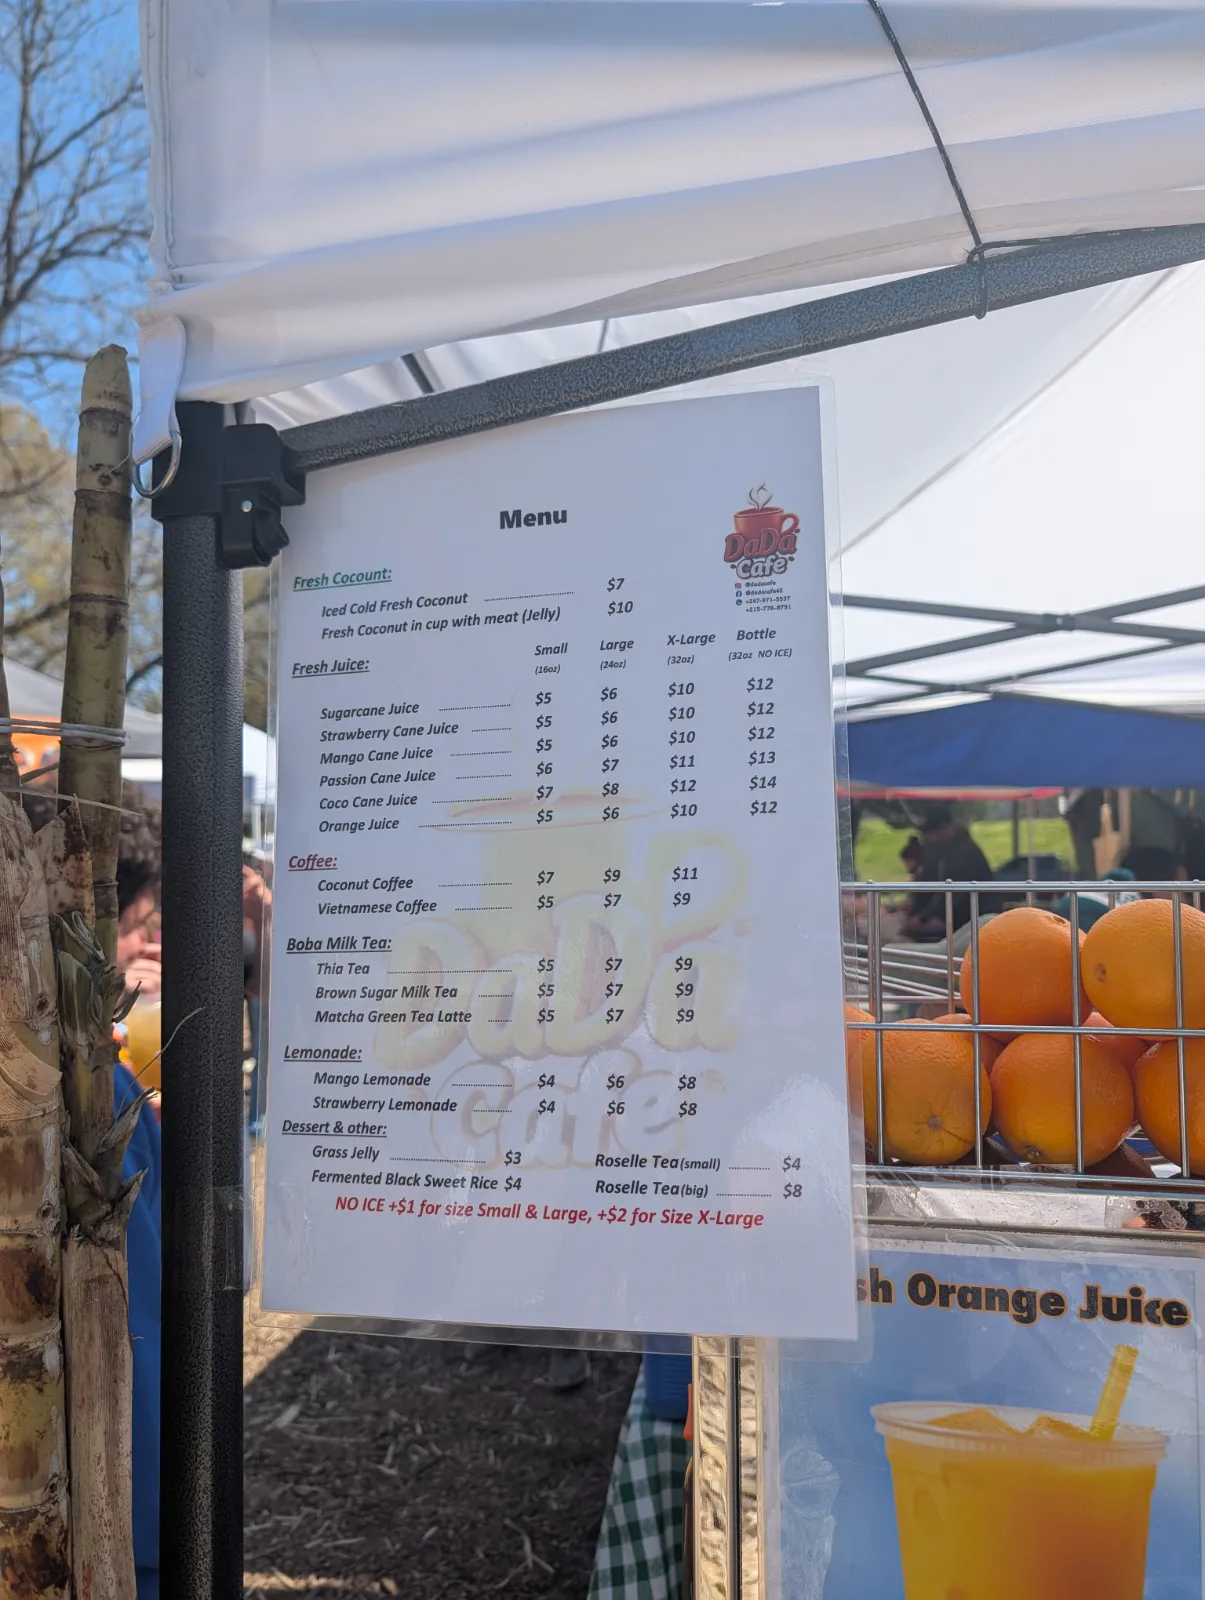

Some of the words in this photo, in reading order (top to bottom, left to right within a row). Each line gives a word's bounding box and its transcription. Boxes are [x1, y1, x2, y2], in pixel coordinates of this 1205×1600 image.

[500, 509, 568, 529] Menu
[724, 528, 797, 562] DaDa
[736, 553, 788, 579] Cafe
[293, 573, 328, 590] Fresh
[332, 568, 392, 585] Cocount:
[322, 605, 346, 618] Iced
[350, 601, 376, 615] Cold
[380, 597, 412, 612] Fresh
[416, 593, 468, 608] Coconut
[607, 578, 624, 592] $7
[322, 626, 354, 639] Fresh
[357, 620, 407, 636] Coconut
[411, 619, 422, 632] in
[426, 619, 448, 631] cup
[452, 612, 480, 627] with
[484, 613, 518, 625] meat
[522, 606, 561, 624] (Jelly)
[607, 600, 633, 615] $10
[535, 642, 568, 656] Small
[600, 639, 634, 652] Large
[667, 633, 716, 646] X-Large
[736, 628, 776, 641] Bottle
[292, 662, 328, 676] Fresh
[331, 657, 370, 673] Juice:
[535, 665, 561, 675] (16oz)
[600, 659, 626, 671] (24oz)
[667, 655, 694, 665] (32oz)
[729, 650, 752, 661] (32oz
[758, 650, 772, 658] NO
[774, 648, 792, 658] ICE)
[320, 705, 385, 722] Sugarcane
[388, 702, 419, 716] Juice
[535, 692, 552, 706] $5
[601, 687, 617, 701] $6
[668, 682, 694, 697] $10
[747, 677, 774, 693] $12
[320, 728, 390, 742] Strawberry
[393, 725, 425, 737] Cane
[427, 723, 458, 736] Juice
[536, 715, 552, 729] $5
[601, 711, 618, 726] $6
[669, 707, 695, 721] $10
[747, 702, 774, 717] $12
[320, 750, 364, 765] Mango
[368, 750, 398, 761] Cane
[402, 748, 433, 760] Juice
[536, 739, 552, 753] $5
[601, 735, 618, 749] $6
[669, 731, 695, 745] $10
[748, 727, 775, 741] $12
[320, 773, 367, 787] Passion
[370, 772, 401, 784] Cane
[404, 770, 436, 783] Juice
[536, 762, 552, 777] $6
[602, 759, 619, 773] $7
[670, 755, 695, 770] $11
[749, 751, 775, 766] $13
[319, 798, 349, 809] Coco
[352, 796, 383, 808] Cane
[386, 794, 417, 807] Juice
[536, 786, 553, 800] $7
[602, 783, 619, 797] $8
[670, 780, 696, 794] $12
[749, 776, 777, 790] $14
[319, 821, 365, 834] Orange
[368, 819, 399, 830] Juice
[536, 809, 553, 824] $5
[602, 807, 619, 821] $6
[671, 804, 697, 819] $10
[750, 800, 777, 815] $12
[288, 854, 337, 870] Coffee:
[318, 879, 368, 892] Coconut
[372, 877, 413, 891] Coffee
[537, 871, 554, 886] $7
[603, 869, 620, 884] $9
[672, 867, 698, 882] $11
[318, 902, 392, 915] Vietnamese
[395, 901, 437, 915] Coffee
[537, 895, 554, 910] $5
[604, 894, 621, 909] $7
[673, 892, 690, 906] $9
[287, 938, 322, 950] Boba
[326, 936, 357, 950] Milk
[361, 937, 392, 949] Tea:
[317, 963, 343, 975] Thia
[347, 963, 370, 974] Tea
[538, 958, 554, 973] $5
[605, 958, 623, 972] $7
[675, 956, 692, 971] $9
[315, 986, 357, 999] Brown
[360, 987, 398, 1001] Sugar
[401, 985, 430, 999] Milk
[434, 986, 457, 998] Tea
[538, 983, 554, 998] $5
[605, 982, 623, 997] $7
[675, 982, 693, 997] $9
[315, 1010, 364, 1023] Matcha
[367, 1011, 406, 1023] Green
[411, 1011, 433, 1022] Tea
[437, 1011, 472, 1022] Latte
[538, 1008, 555, 1023] $5
[606, 1008, 624, 1023] $7
[676, 1008, 694, 1024] $9
[284, 1045, 362, 1060] Lemonade:
[314, 1072, 360, 1087] Mango
[363, 1073, 431, 1086] Lemonade
[538, 1074, 555, 1089] $4
[607, 1075, 625, 1090] $6
[678, 1075, 696, 1091] $8
[313, 1097, 384, 1112] Strawberry
[388, 1099, 457, 1112] Lemonade
[538, 1099, 556, 1114] $4
[607, 1101, 625, 1116] $6
[678, 1101, 697, 1117] $8
[282, 1120, 330, 1133] Dessert
[333, 1122, 343, 1133] &
[347, 1122, 387, 1135] other:
[312, 1146, 348, 1159] Grass
[351, 1147, 379, 1162] Jelly
[504, 1150, 521, 1165] $3
[595, 1154, 647, 1168] Roselle
[782, 1156, 801, 1171] $4
[312, 1170, 381, 1185] Fermented
[385, 1173, 420, 1187] Black
[424, 1175, 466, 1188] Sweet
[470, 1176, 498, 1189] Rice
[504, 1176, 522, 1191] $4
[595, 1180, 648, 1194] Roselle
[783, 1183, 802, 1199] $8
[335, 1197, 359, 1210] NO
[362, 1198, 385, 1211] ICE
[389, 1197, 414, 1214] +$1
[418, 1200, 442, 1217] for
[445, 1203, 473, 1216] size
[477, 1202, 521, 1218] Small
[525, 1204, 537, 1219] &
[543, 1205, 592, 1224] Large,
[597, 1206, 627, 1225] +$2
[630, 1207, 656, 1226] for
[661, 1209, 693, 1224] Size
[697, 1210, 764, 1228] X-Large
[907, 1271, 1067, 1326] Orange
[1077, 1284, 1192, 1328] Juice
